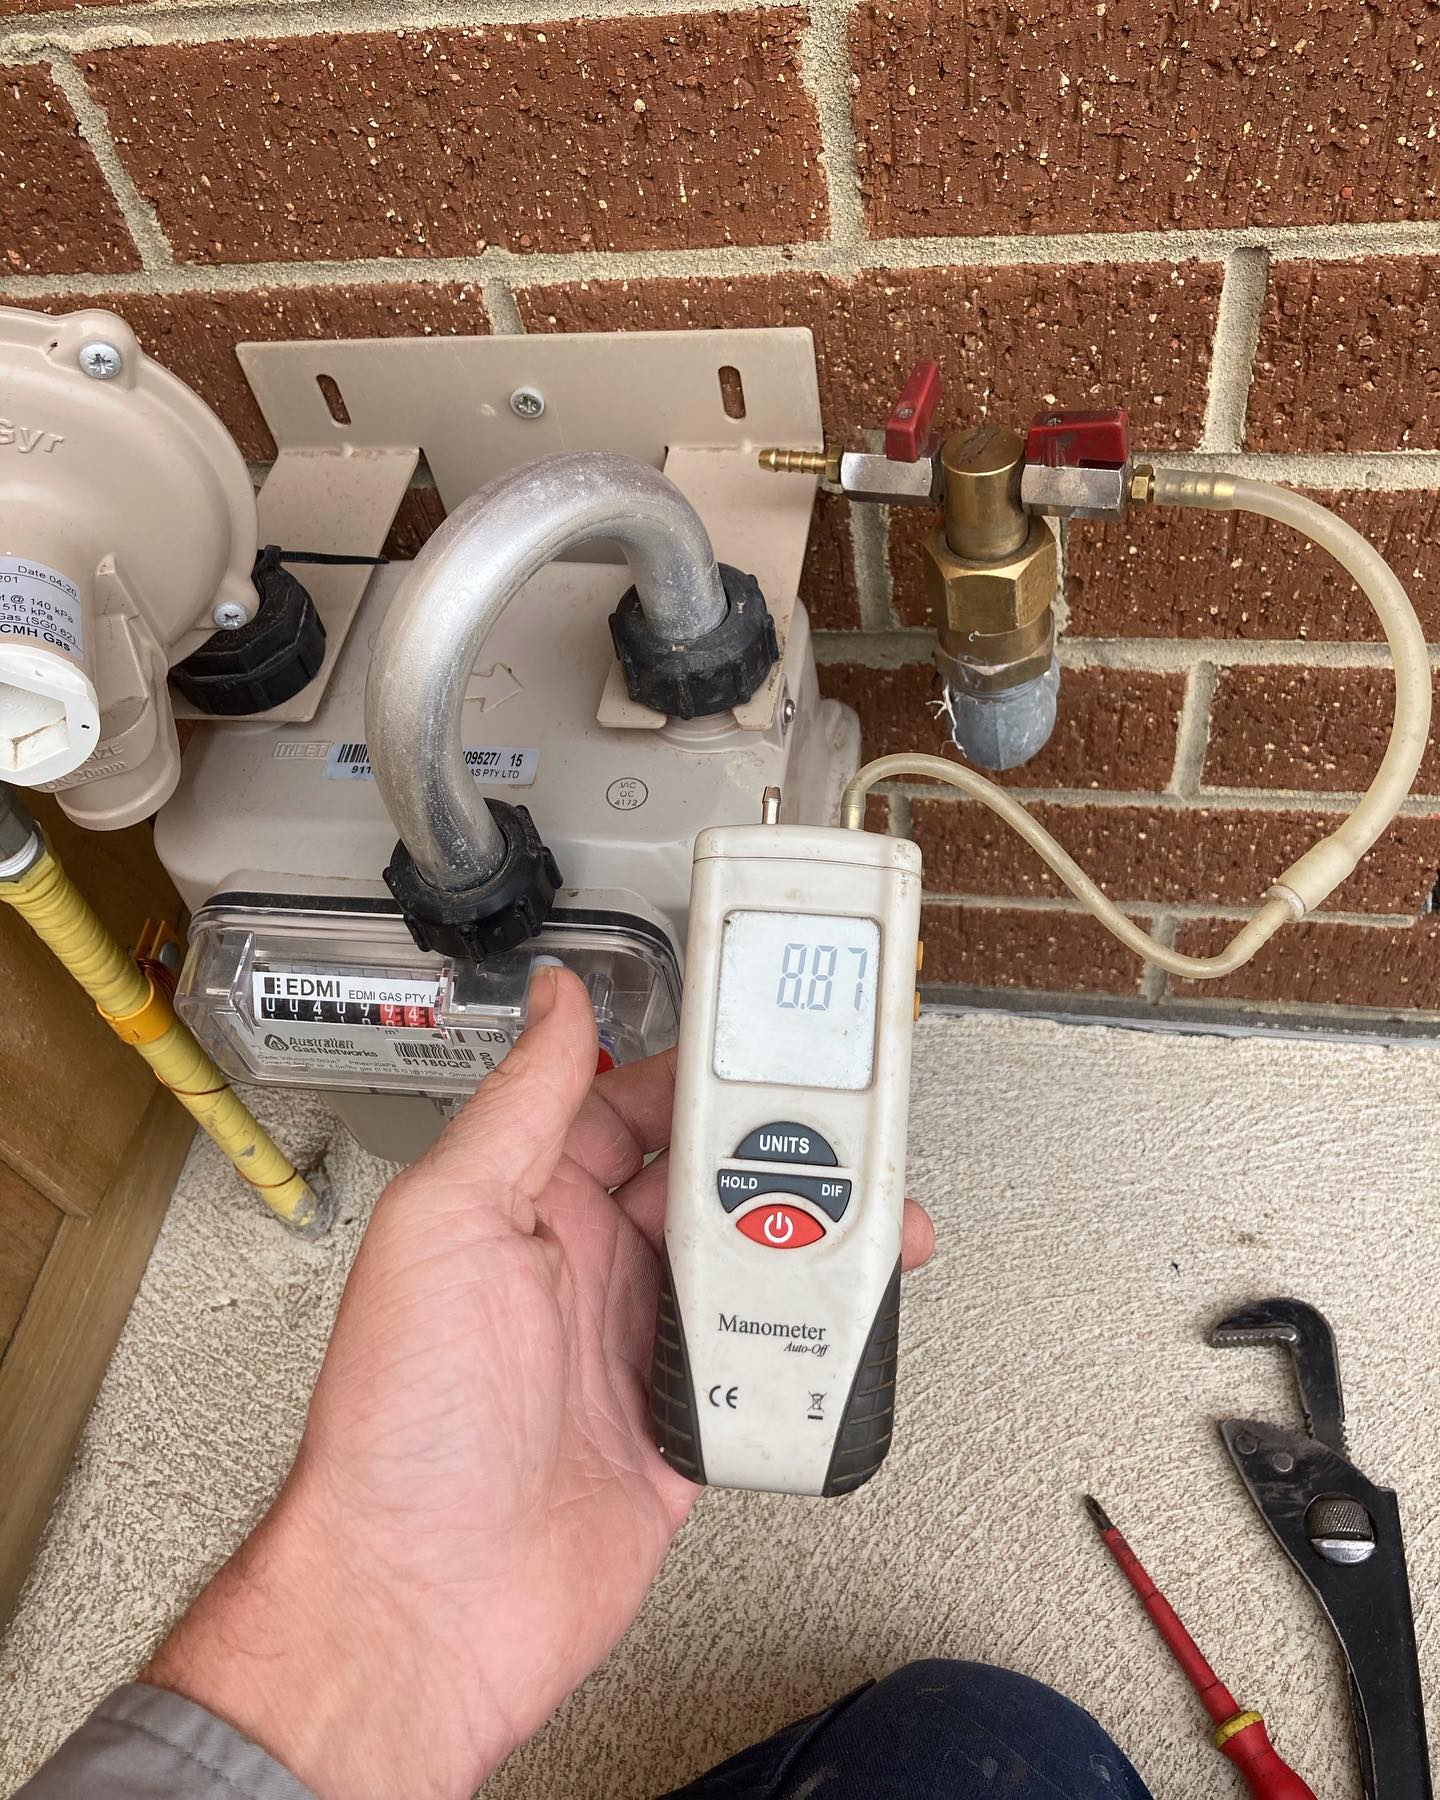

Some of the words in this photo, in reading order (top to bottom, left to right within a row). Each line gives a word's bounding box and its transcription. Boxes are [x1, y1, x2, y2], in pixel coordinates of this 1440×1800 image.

[17, 565, 46, 579] Date
[49, 575, 77, 597] 04-20
[2, 603, 26, 612] 515
[31, 608, 53, 621] kPa
[31, 598, 51, 610] 140
[43, 632, 71, 652] Gas
[463, 750, 501, 766] 09527/
[510, 754, 524, 767] 15
[351, 765, 373, 774] 911
[482, 769, 500, 778] PTY
[502, 770, 520, 779] LTD
[776, 943, 868, 1011] 8.87
[286, 978, 341, 998] EDMI
[349, 989, 376, 1000] EDMI
[379, 991, 402, 1002] GAS
[404, 993, 425, 1004] PTY
[289, 1036, 355, 1049] Australian
[476, 1031, 506, 1044] U8
[403, 1058, 472, 1069] 91180QG
[759, 1134, 810, 1154] UNITS
[720, 1175, 758, 1189] HOLD
[821, 1183, 843, 1197] DIF
[718, 1313, 826, 1340] Manometer
[784, 1341, 830, 1357] Auto-Off
[709, 1385, 738, 1409] CE
